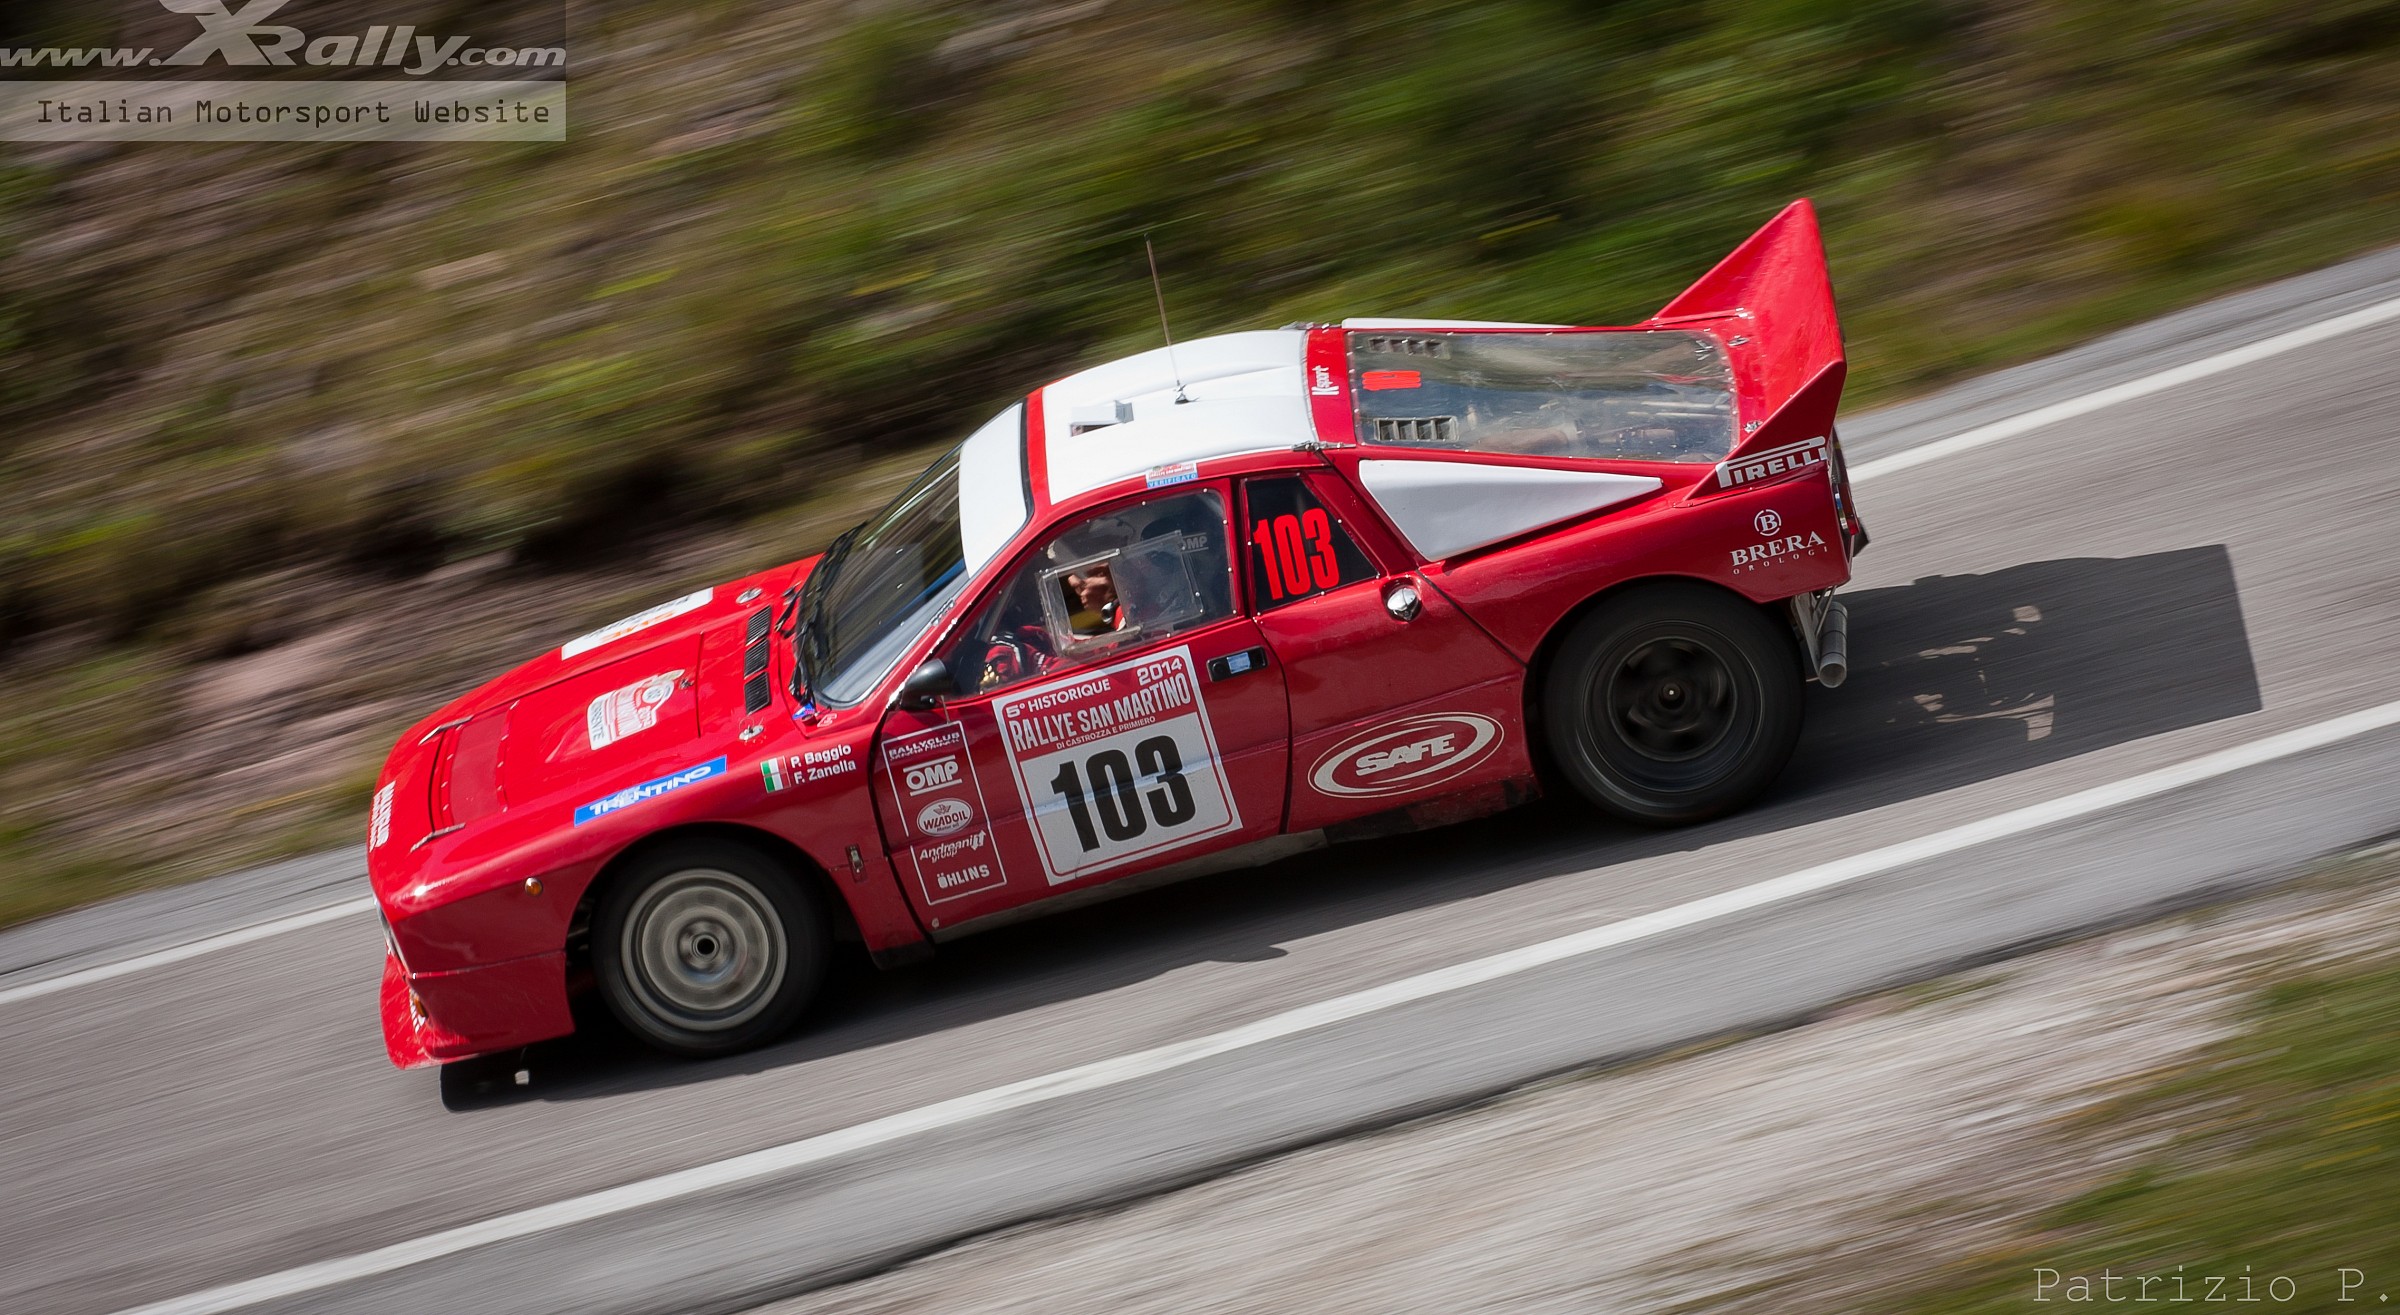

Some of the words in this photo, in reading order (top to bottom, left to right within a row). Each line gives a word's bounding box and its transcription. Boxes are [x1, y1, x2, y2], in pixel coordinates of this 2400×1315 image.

[1716, 435, 1828, 489] PIRELLI
[1252, 507, 1340, 600] 103
[1729, 531, 1825, 567] BRERA
[1733, 546, 1828, 575] OROLOGI
[1028, 679, 1111, 713] HISTORIQUE
[1136, 657, 1183, 686] 2014
[1008, 712, 1077, 752] RALLYE
[1077, 703, 1115, 733] SAN
[1113, 672, 1192, 723] MARTINO
[1056, 741, 1065, 750] DI
[1065, 729, 1112, 747] CASTROZZA
[1111, 726, 1119, 734] E
[1118, 716, 1157, 732] PRIMIERO
[790, 756, 802, 769] P.
[804, 744, 852, 765] Baggio
[793, 771, 805, 784] F.
[807, 760, 857, 781] Zanella
[1355, 733, 1455, 776] SAFE
[906, 761, 959, 790] OMP
[1050, 735, 1197, 853] 103
